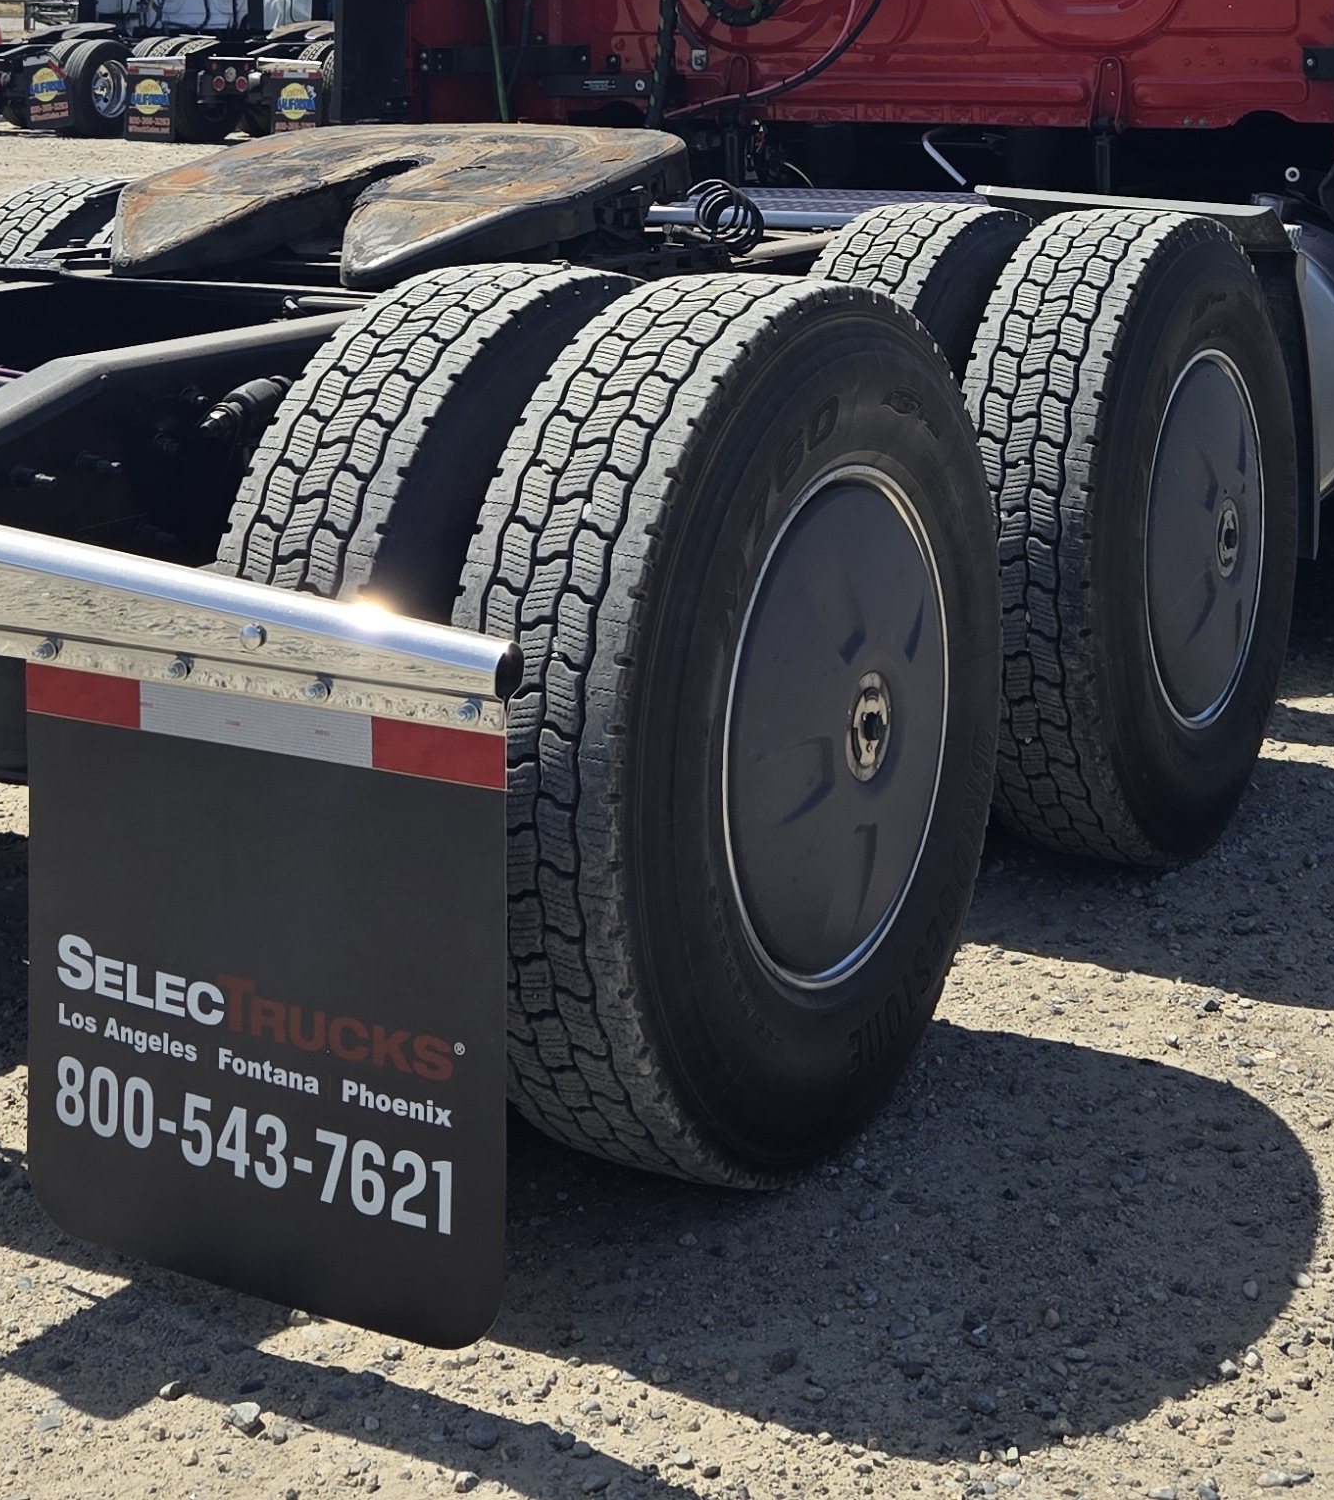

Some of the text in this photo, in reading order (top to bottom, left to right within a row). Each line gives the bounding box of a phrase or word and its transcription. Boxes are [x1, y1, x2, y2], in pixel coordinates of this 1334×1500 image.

[58, 1002, 453, 1128] Los Angeles Fontana Phoenix
[55, 1055, 453, 1235] 800-543-7621
